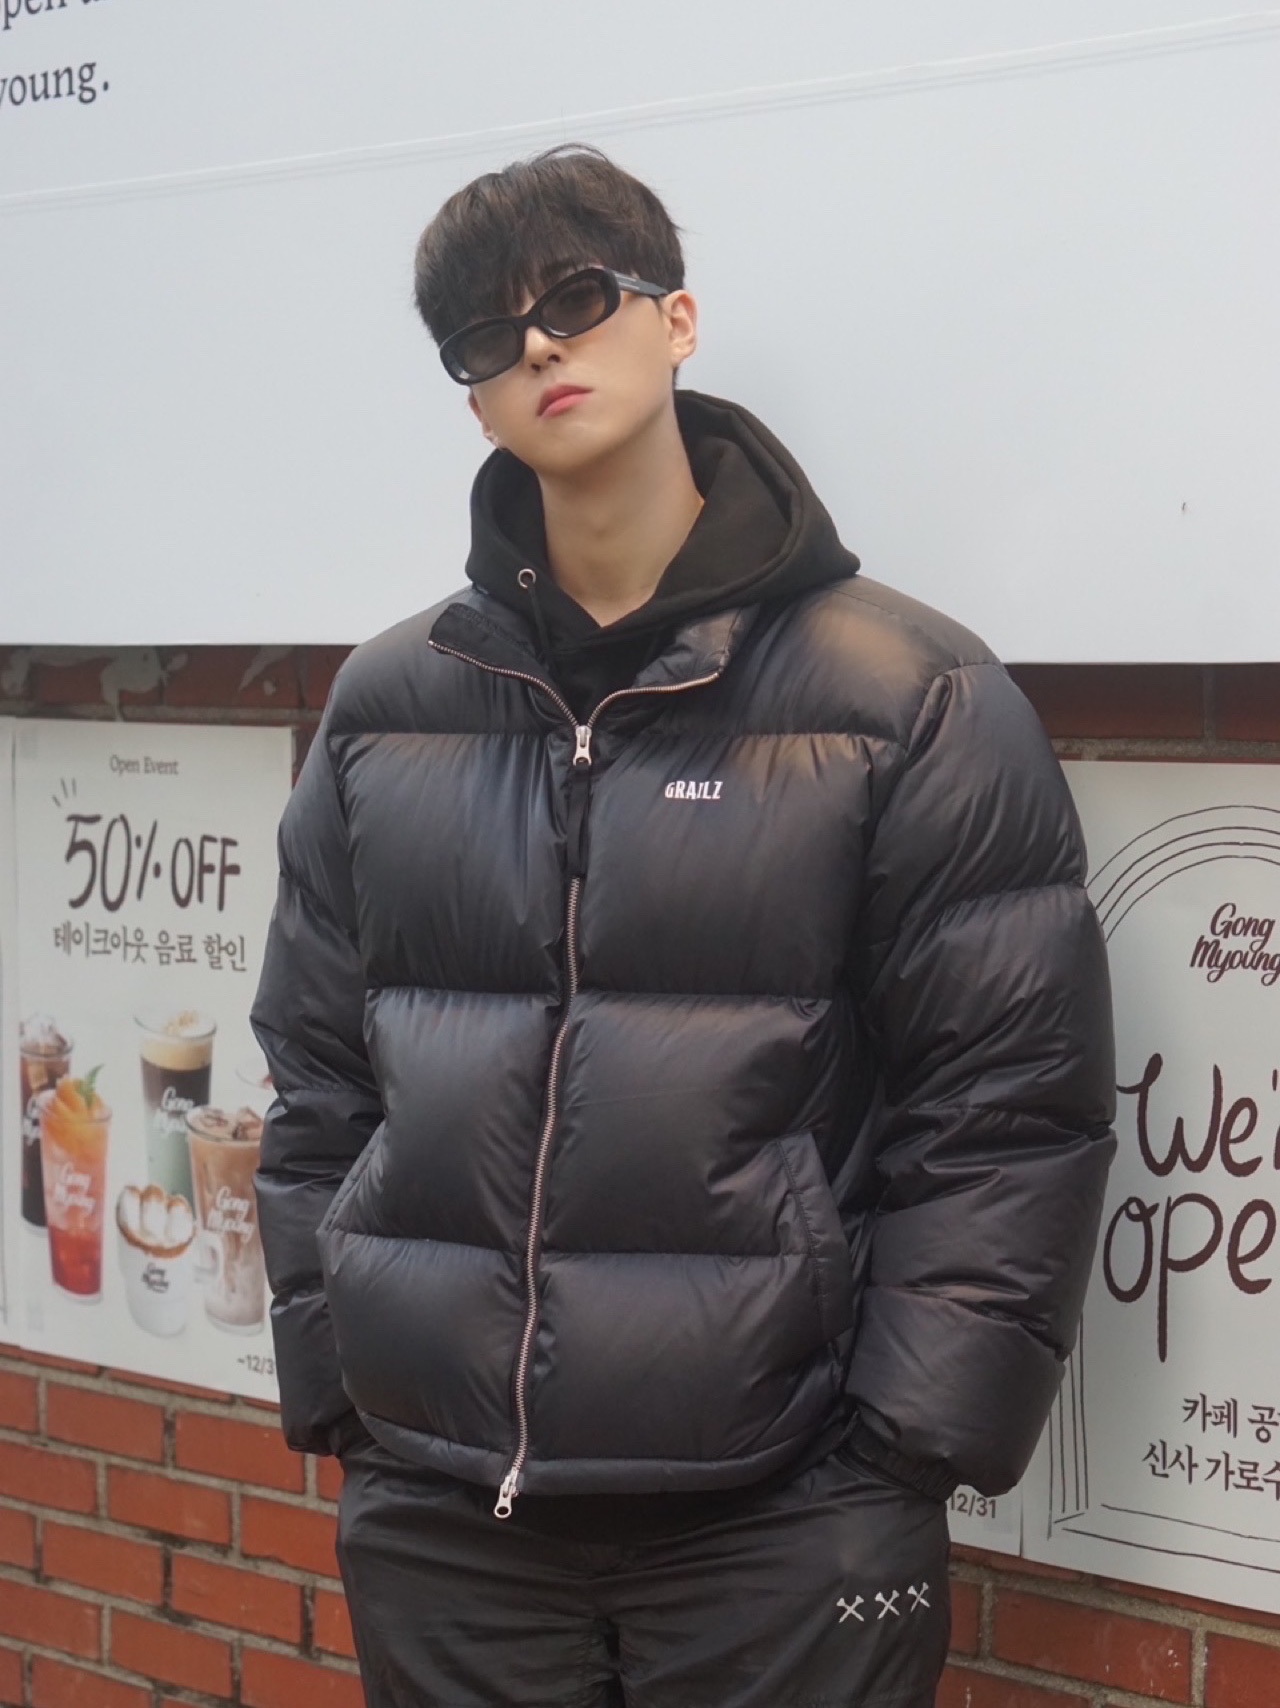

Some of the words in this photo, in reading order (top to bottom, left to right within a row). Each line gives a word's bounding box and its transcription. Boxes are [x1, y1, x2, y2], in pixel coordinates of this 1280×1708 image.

[109, 754, 140, 777] Open
[143, 756, 179, 775] Event
[664, 780, 723, 800] GRAILZ
[65, 814, 162, 912] 50%
[171, 834, 241, 912] OFF
[53, 920, 149, 964] 테이크아웃
[153, 929, 197, 966] 음료
[203, 933, 247, 972] 할인
[1210, 902, 1276, 953] Gong
[1189, 934, 1280, 986] Myoung
[1116, 1053, 1280, 1177] We'
[1103, 1193, 1277, 1363] ope
[1182, 1392, 1237, 1438] 카페
[1247, 1404, 1280, 1443] 공
[1142, 1438, 1199, 1485] 신사
